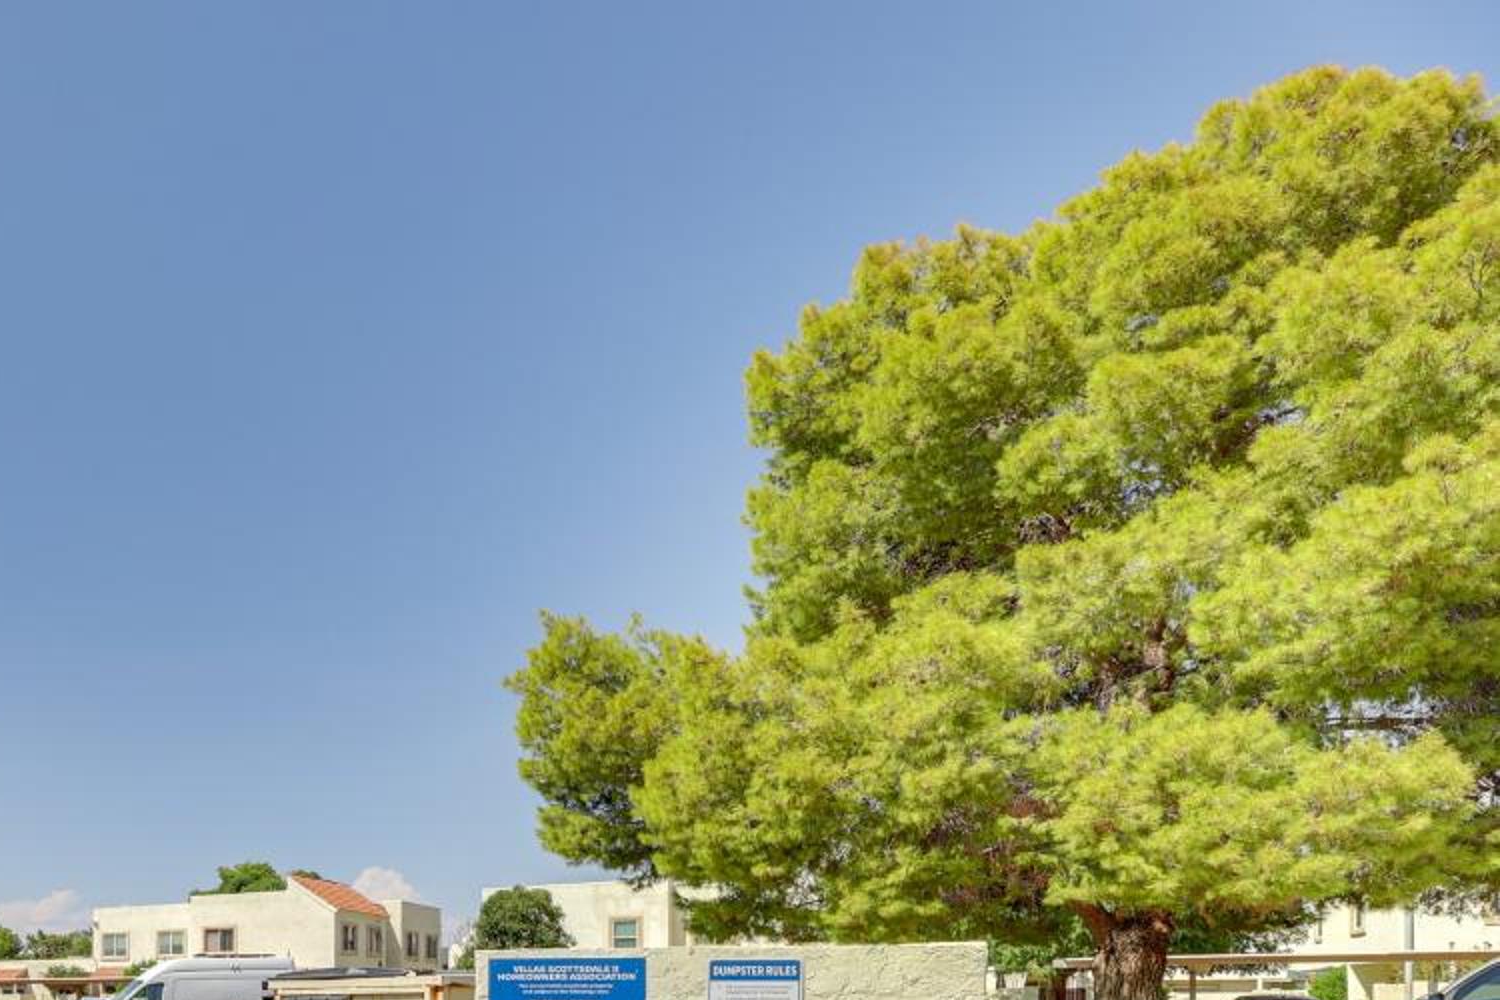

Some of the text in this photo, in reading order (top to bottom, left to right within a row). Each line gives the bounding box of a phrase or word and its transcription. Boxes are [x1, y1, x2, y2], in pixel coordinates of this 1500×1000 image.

[513, 965, 546, 973] VILLAS
[548, 965, 609, 973] SCOTTSDALE
[713, 965, 797, 976] DUMPSTER RULES
[497, 973, 636, 981] HOMEOWNERS ASSOCIATION
